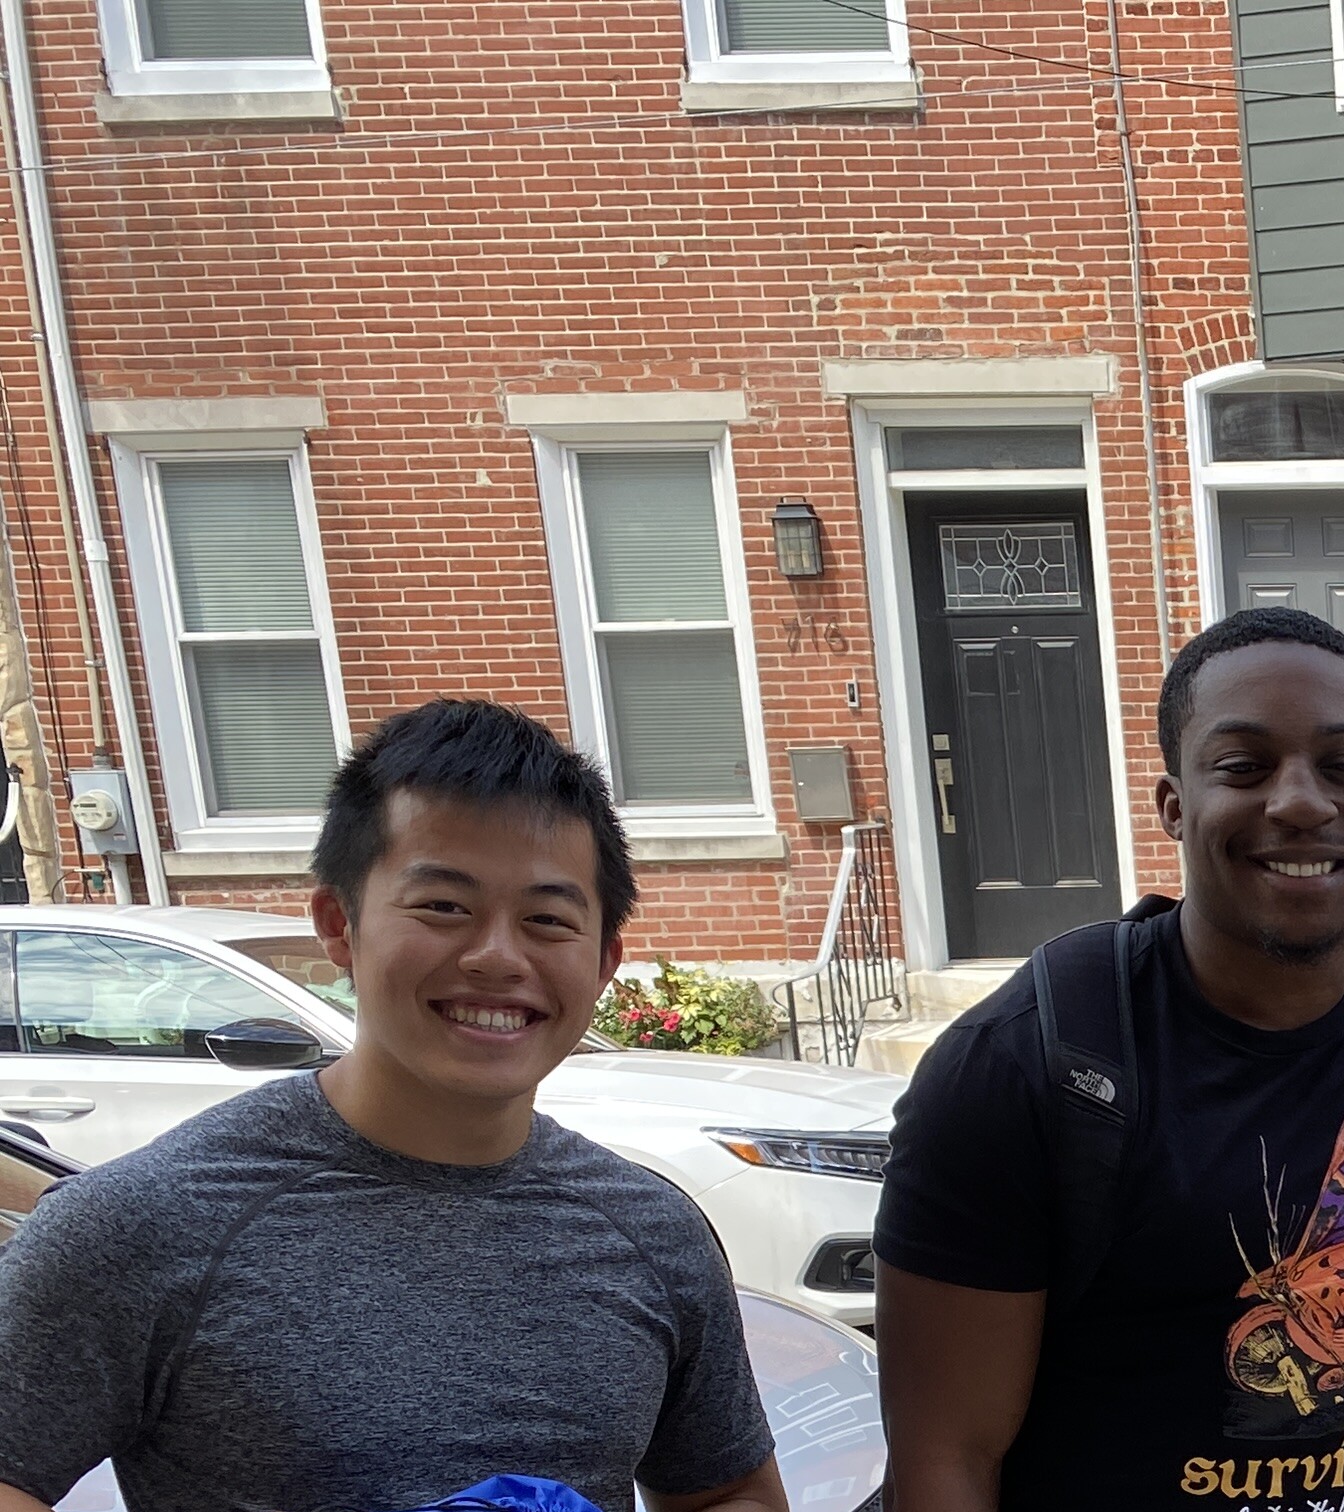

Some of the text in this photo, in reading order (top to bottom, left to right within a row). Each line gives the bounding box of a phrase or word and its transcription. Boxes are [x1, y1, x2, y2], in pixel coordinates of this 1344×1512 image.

[1069, 1069, 1100, 1088] NORTH
[1087, 1069, 1104, 1082] THE
[1074, 1079, 1098, 1095] FACE
